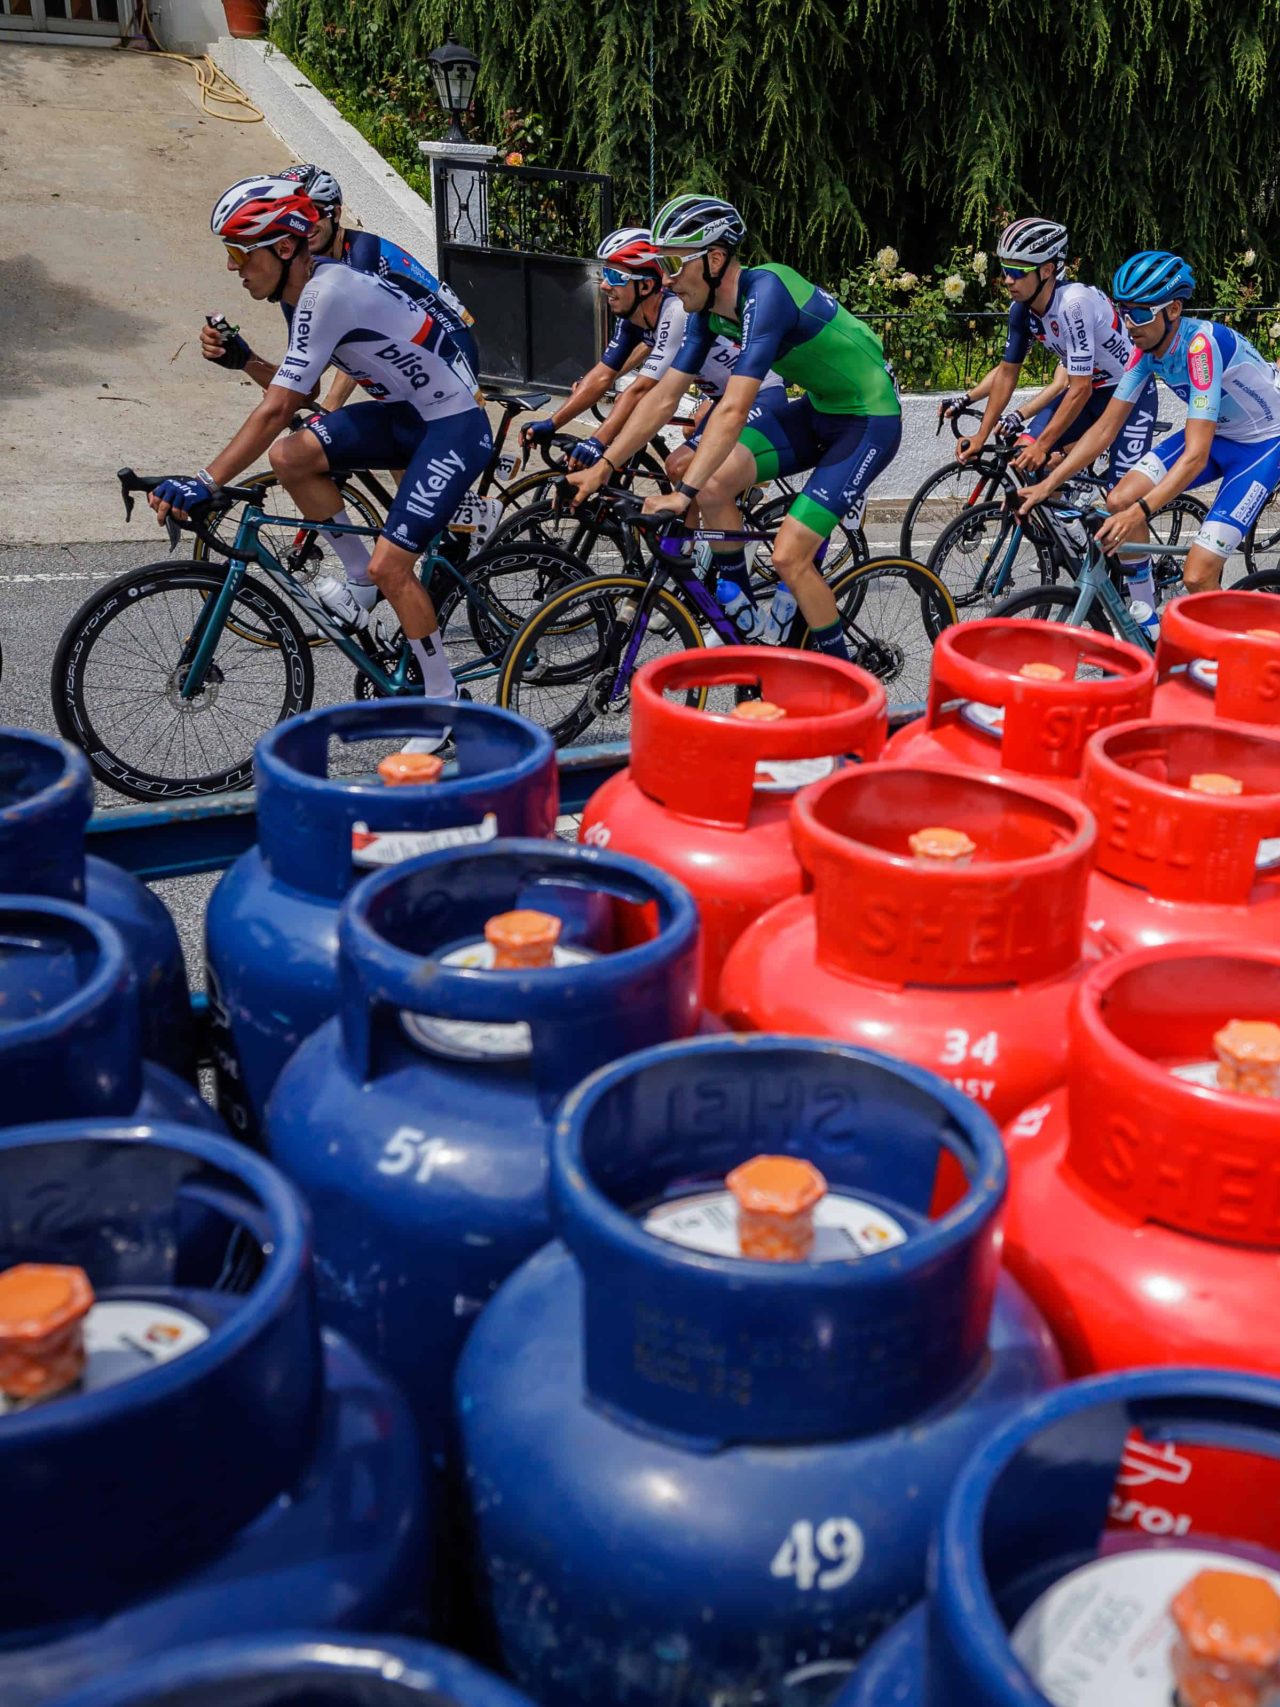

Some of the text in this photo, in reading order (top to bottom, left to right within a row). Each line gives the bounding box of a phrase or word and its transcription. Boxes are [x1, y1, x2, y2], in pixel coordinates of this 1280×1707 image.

[410, 449, 466, 508] Kelly
[853, 448, 877, 486] CORTIZO
[567, 587, 635, 606] metron
[939, 1027, 999, 1067] 34
[767, 1515, 866, 1592] 49
